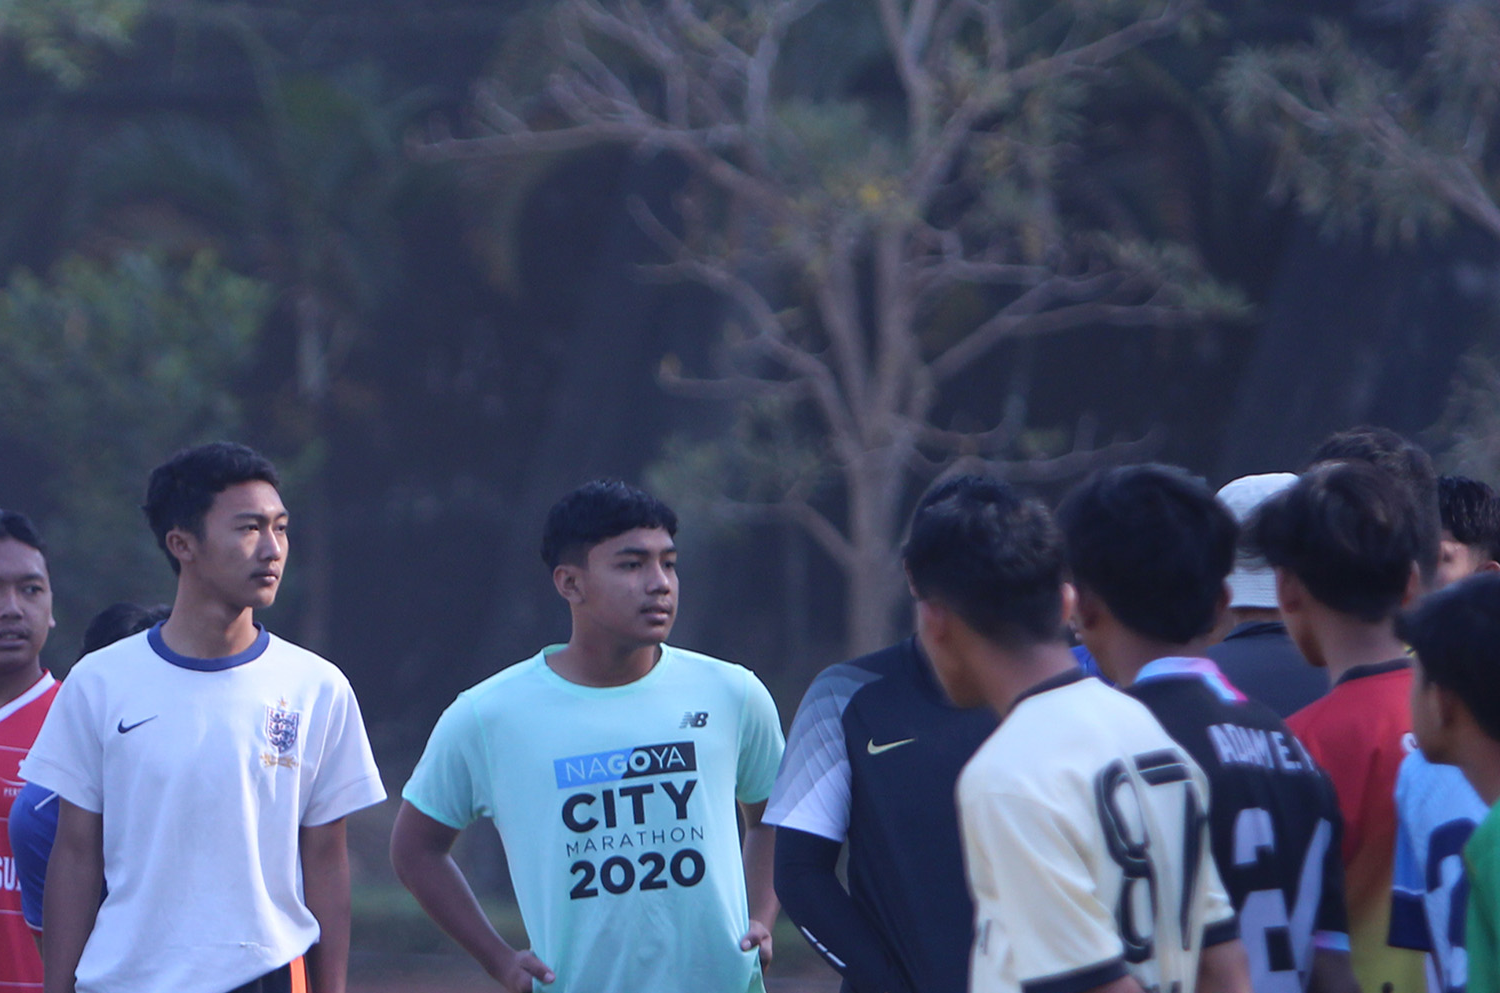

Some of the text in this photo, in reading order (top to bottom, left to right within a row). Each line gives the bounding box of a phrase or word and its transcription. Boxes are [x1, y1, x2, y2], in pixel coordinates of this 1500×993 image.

[565, 746, 686, 781] NAGOYA
[561, 779, 698, 834] CITY
[566, 825, 705, 858] MARATHON
[1093, 747, 1205, 964] 87
[570, 848, 706, 900] 2020
